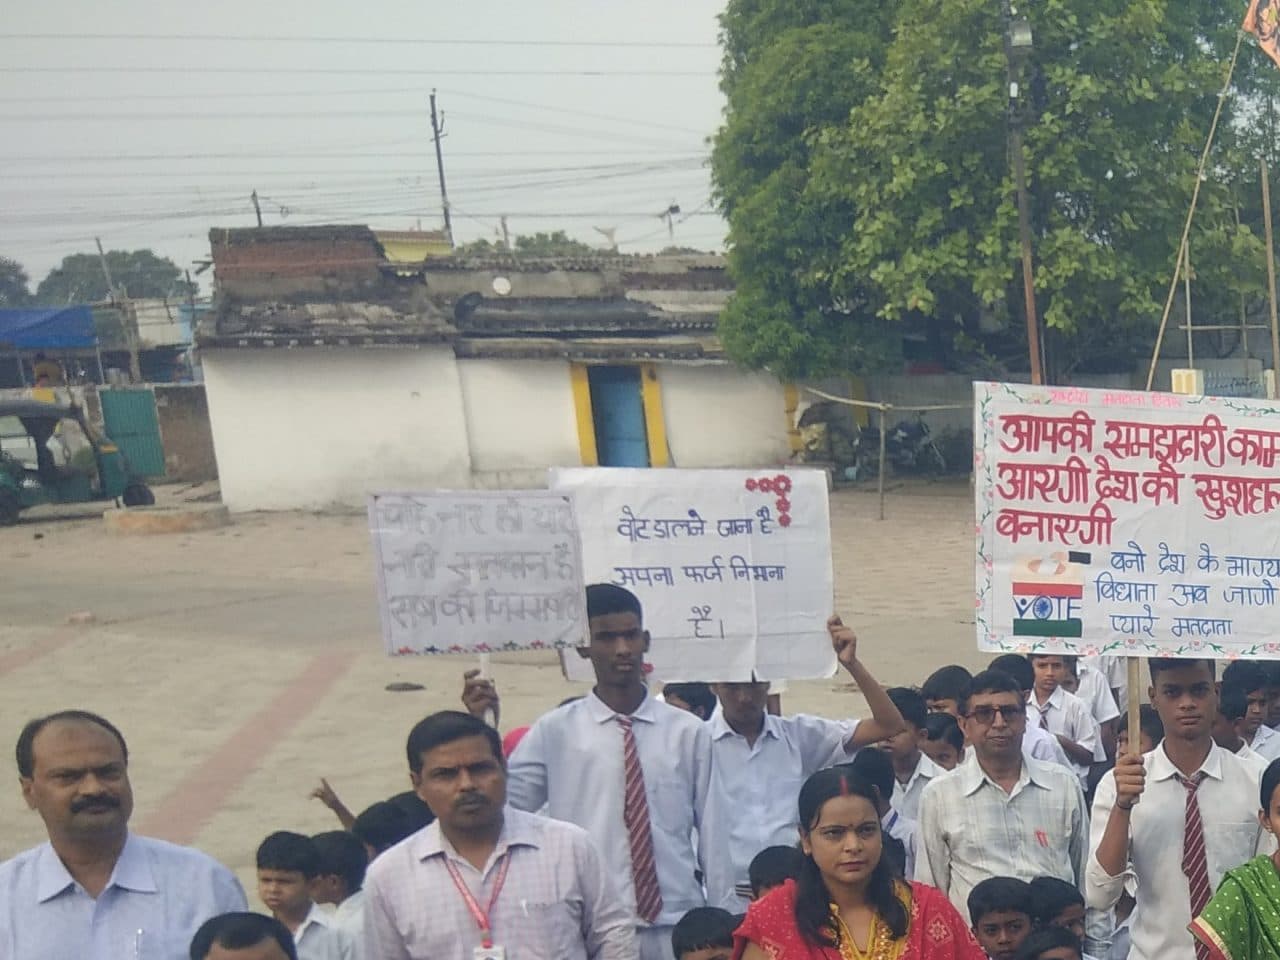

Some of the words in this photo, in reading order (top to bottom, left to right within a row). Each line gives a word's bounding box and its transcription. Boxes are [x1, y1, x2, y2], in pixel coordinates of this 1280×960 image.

[999, 410, 1096, 453] आपकी
[1104, 414, 1228, 469] समझदारी
[996, 456, 1092, 503] आएगी
[1095, 455, 1139, 503] देश
[1142, 462, 1186, 506] को
[617, 505, 651, 542] वोट
[654, 509, 707, 538] डालने
[717, 519, 753, 537] जाना
[756, 506, 774, 534] है
[996, 503, 1117, 545] बनाएगी
[1111, 541, 1147, 573] बनो
[1158, 542, 1186, 575] देश
[1197, 543, 1222, 573] के
[612, 566, 676, 587] अपना
[1168, 584, 1211, 607] अब
[1223, 579, 1280, 606] जागो
[1013, 595, 1082, 620] VOTE
[1109, 604, 1160, 637] प्यारे
[1172, 616, 1233, 637] मतदाता
